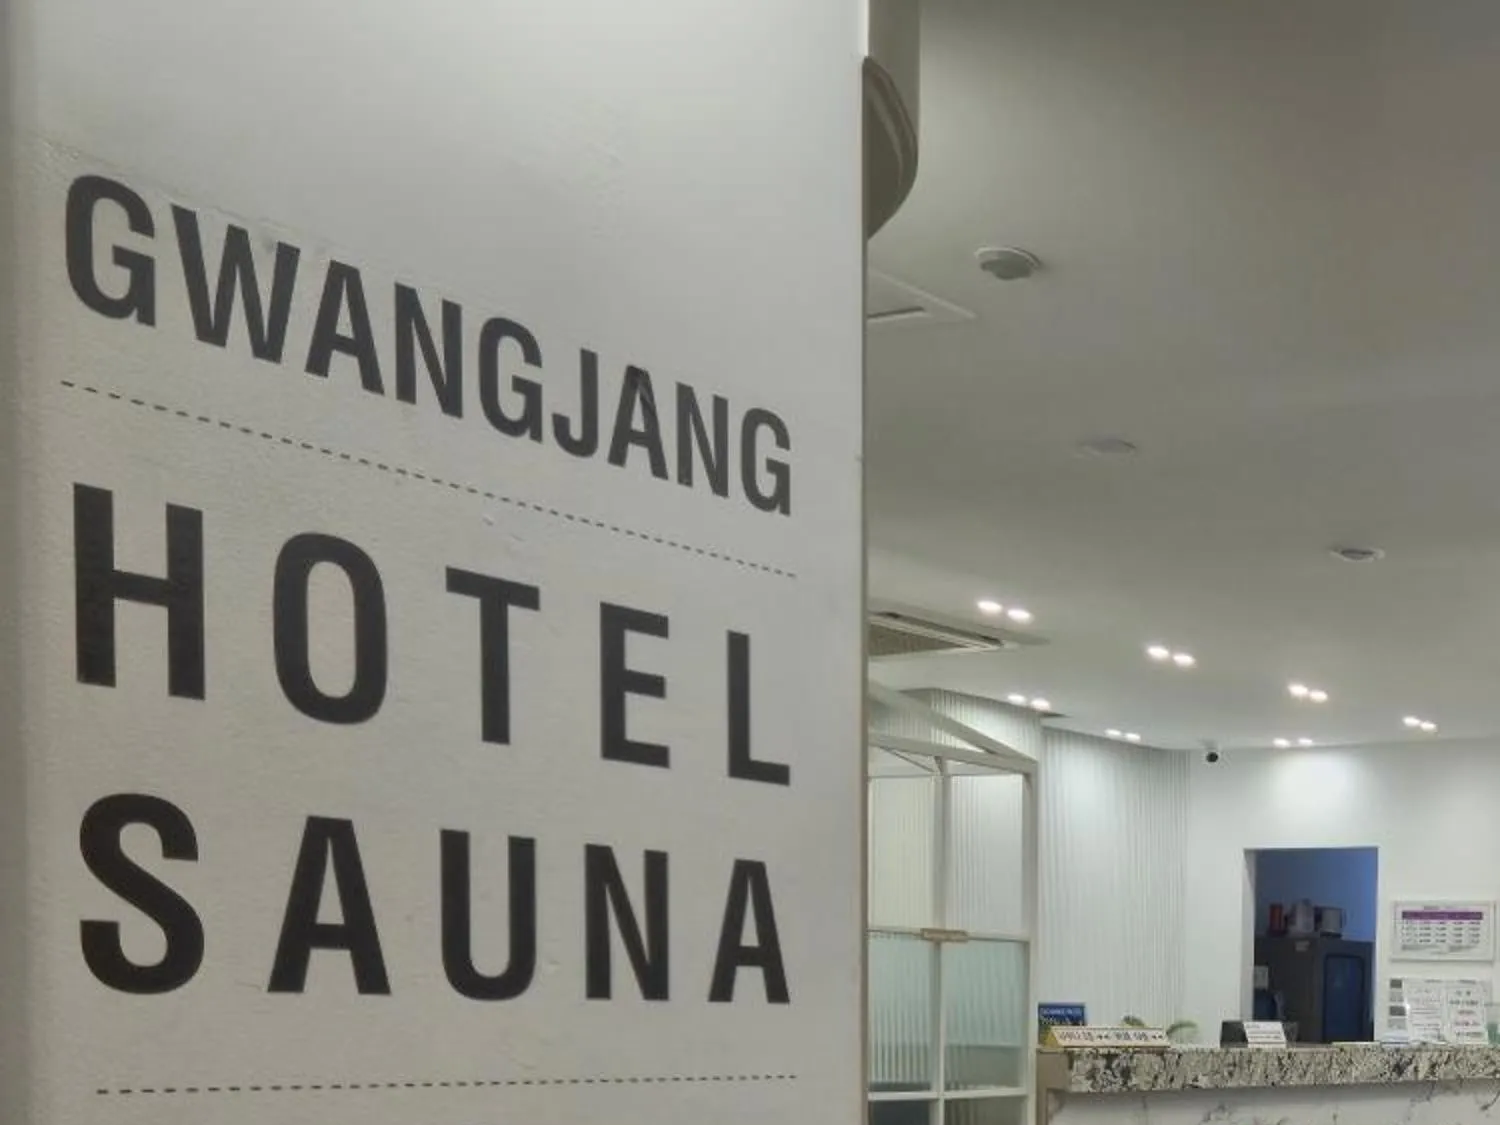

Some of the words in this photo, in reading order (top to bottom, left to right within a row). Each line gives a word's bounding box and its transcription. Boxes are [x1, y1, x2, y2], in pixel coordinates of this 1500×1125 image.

[65, 174, 792, 516] GWANGJANG
[73, 481, 791, 787] HOTEL
[78, 792, 791, 1005] SAUNA
